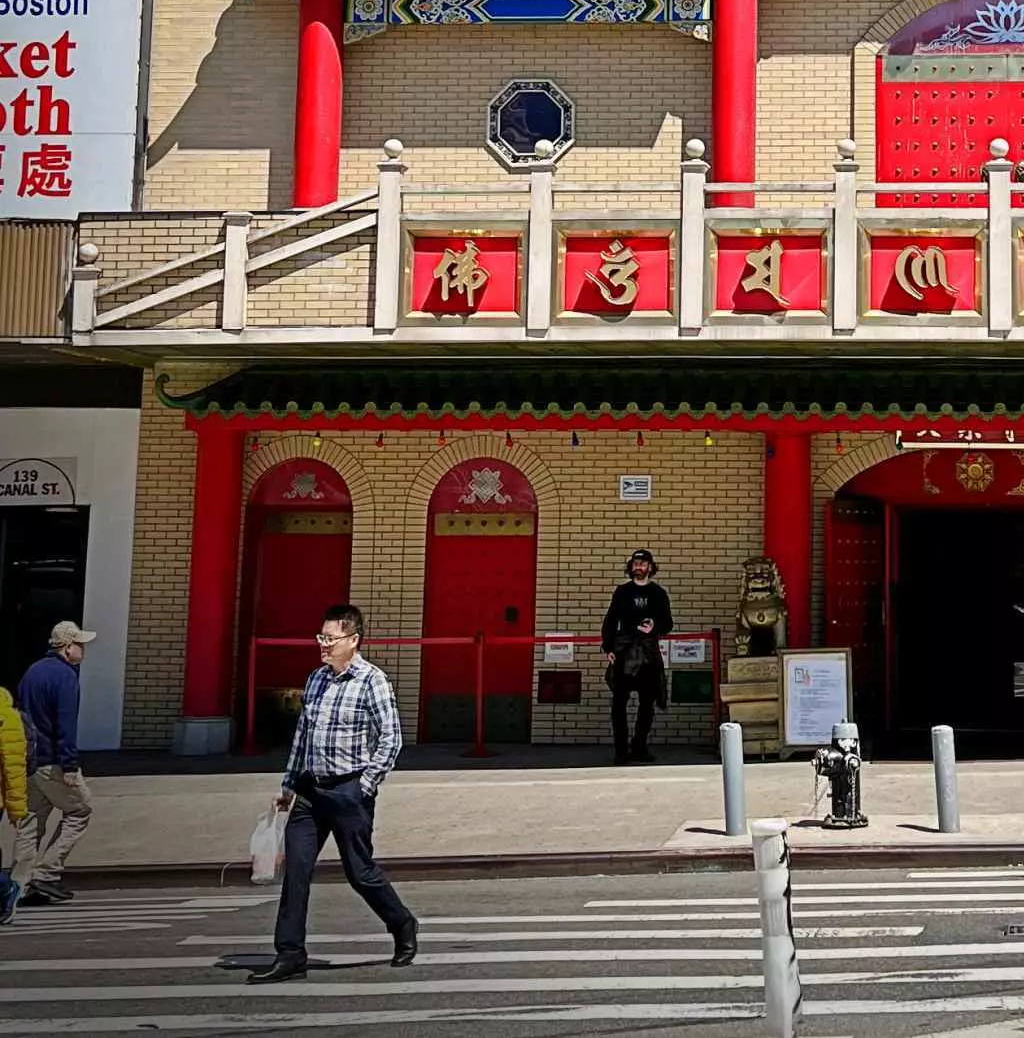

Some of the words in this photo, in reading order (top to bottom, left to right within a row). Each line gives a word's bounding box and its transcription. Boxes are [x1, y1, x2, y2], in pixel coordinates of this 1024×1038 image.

[0, 85, 72, 136] th
[0, 143, 72, 198] 處
[432, 240, 489, 307] 佛
[13, 469, 38, 483] 139
[41, 482, 60, 495] ST.
